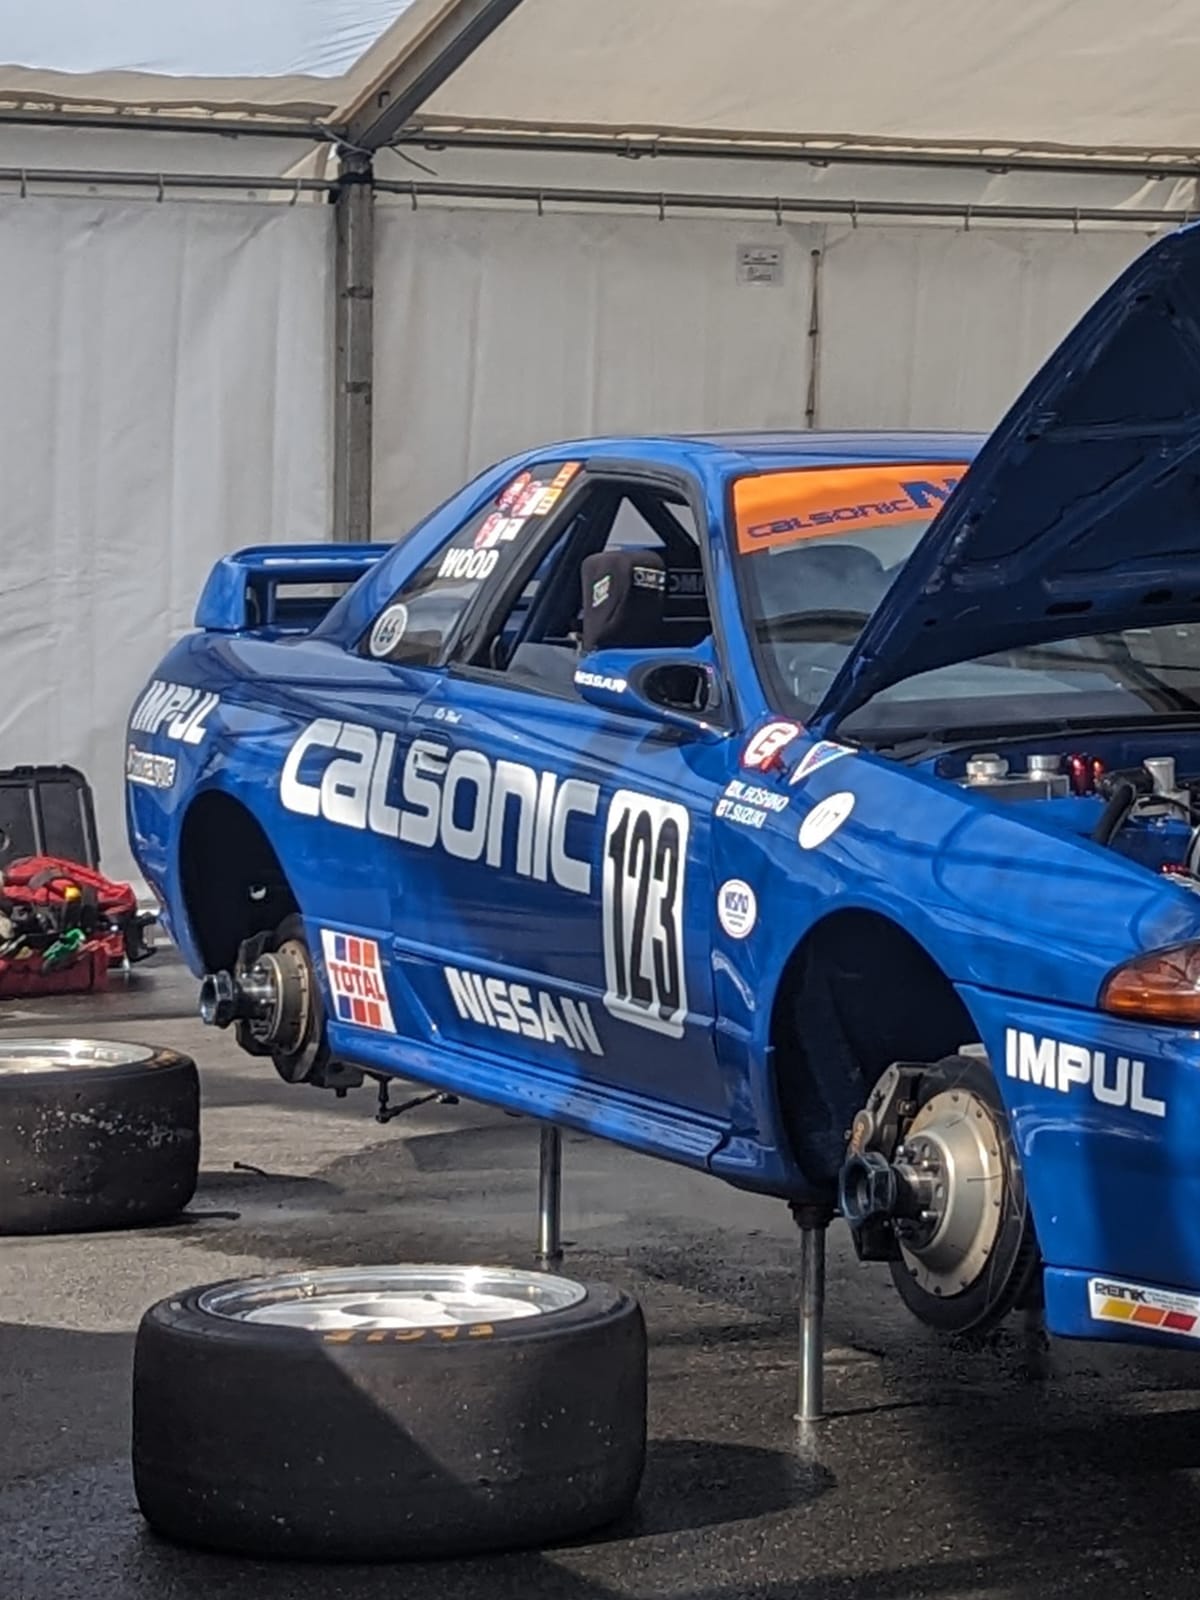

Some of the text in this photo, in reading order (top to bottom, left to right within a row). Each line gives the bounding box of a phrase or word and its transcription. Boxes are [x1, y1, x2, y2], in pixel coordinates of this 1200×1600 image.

[437, 547, 499, 579] WOOD
[130, 679, 220, 745] IMPUL
[609, 807, 680, 1019] 123
[328, 961, 386, 1002] TOTAL
[444, 966, 604, 1056] NISSAN
[1005, 1027, 1166, 1117] IMPUL
